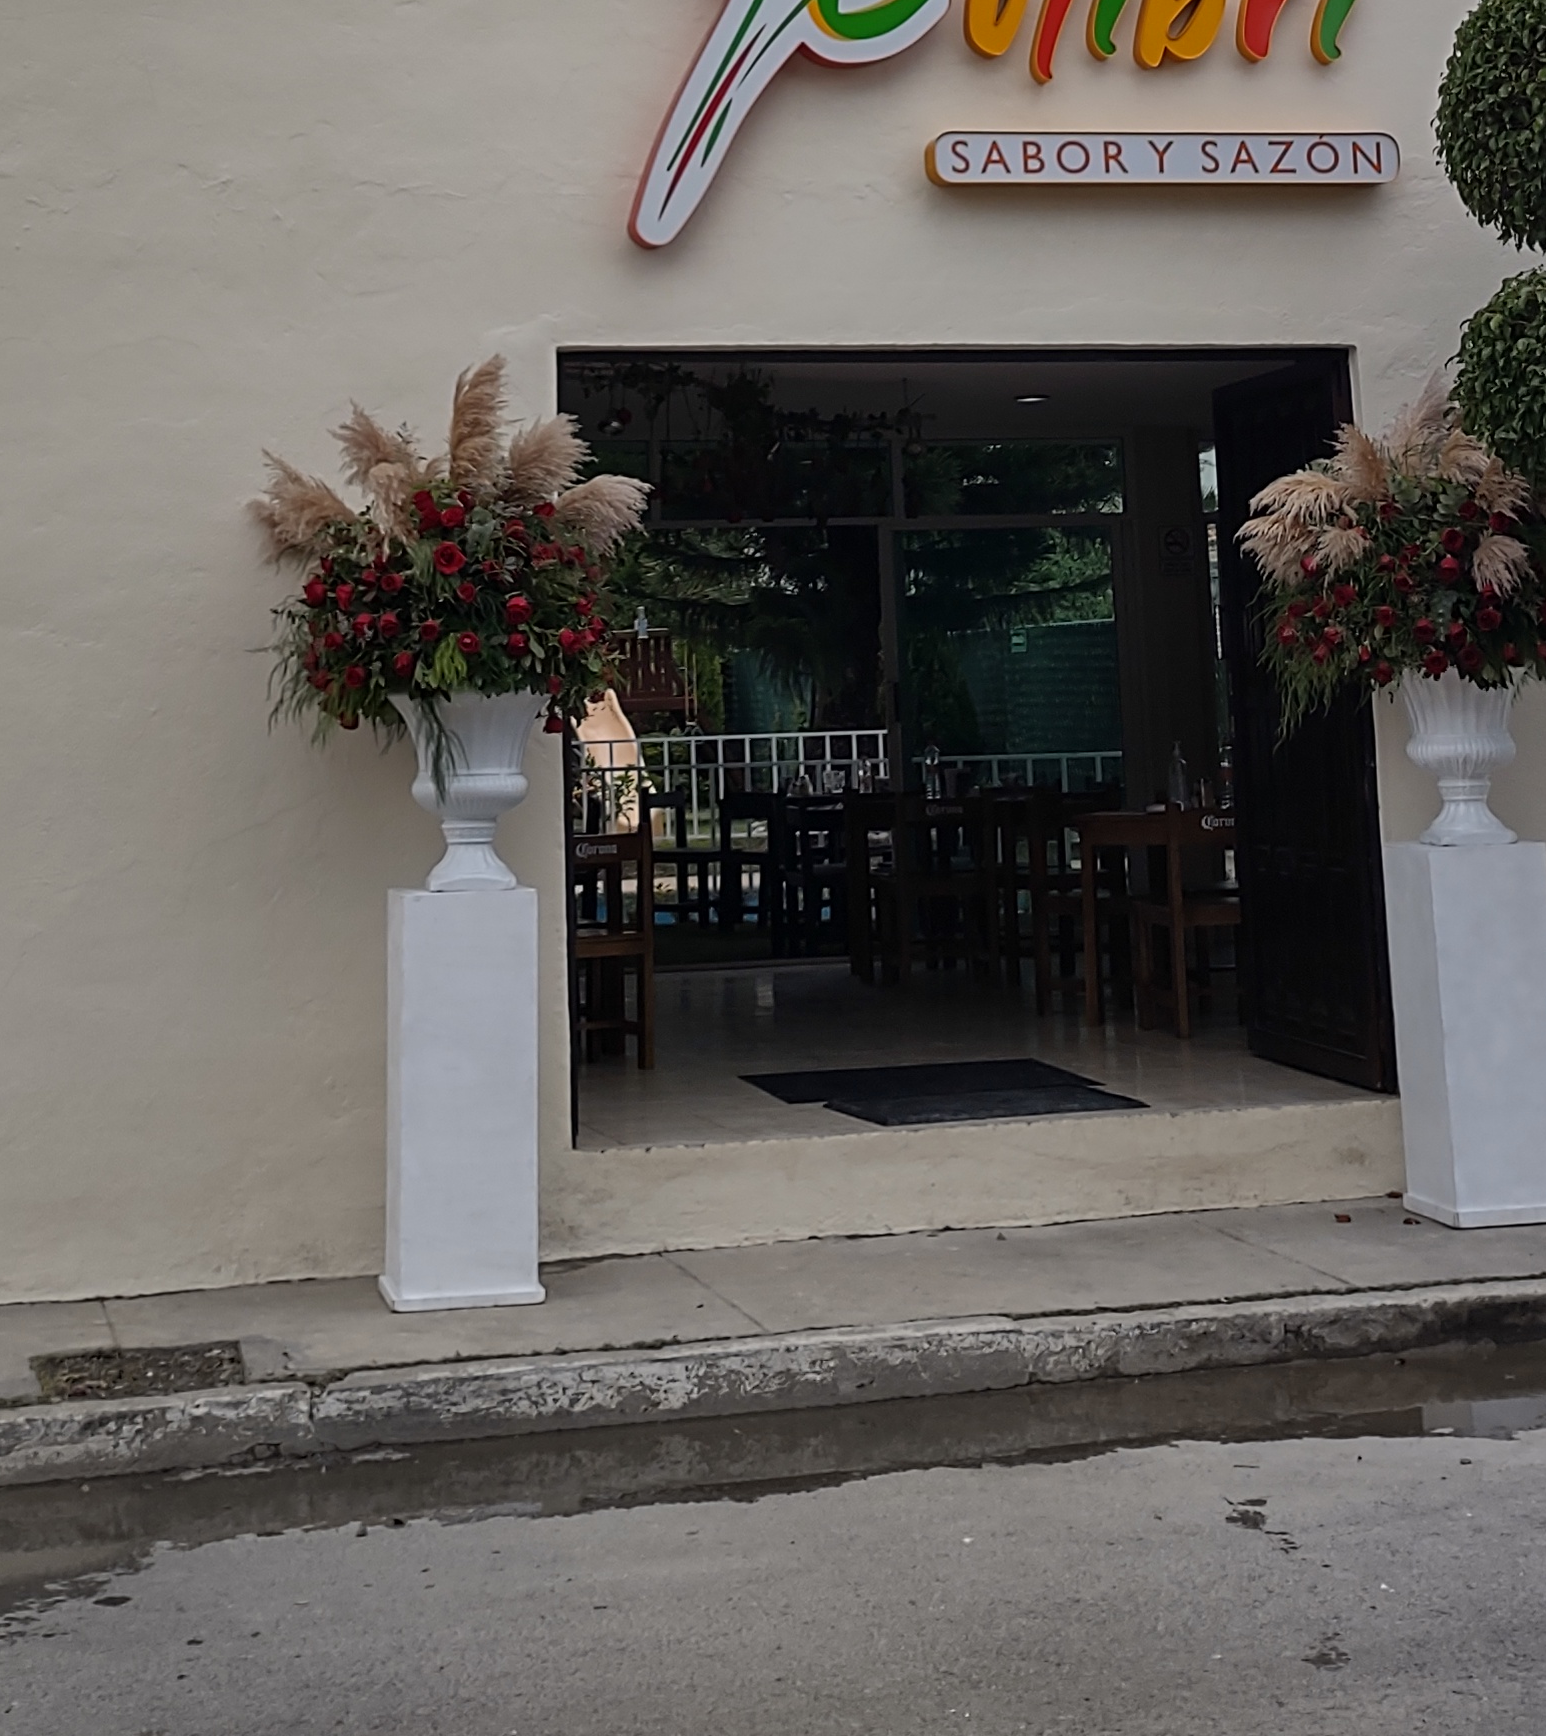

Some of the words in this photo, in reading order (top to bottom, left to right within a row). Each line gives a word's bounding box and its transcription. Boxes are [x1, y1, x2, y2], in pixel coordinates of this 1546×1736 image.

[950, 140, 1130, 175] SABOR
[1147, 140, 1175, 174] Y
[1200, 134, 1384, 175] SAZÓN
